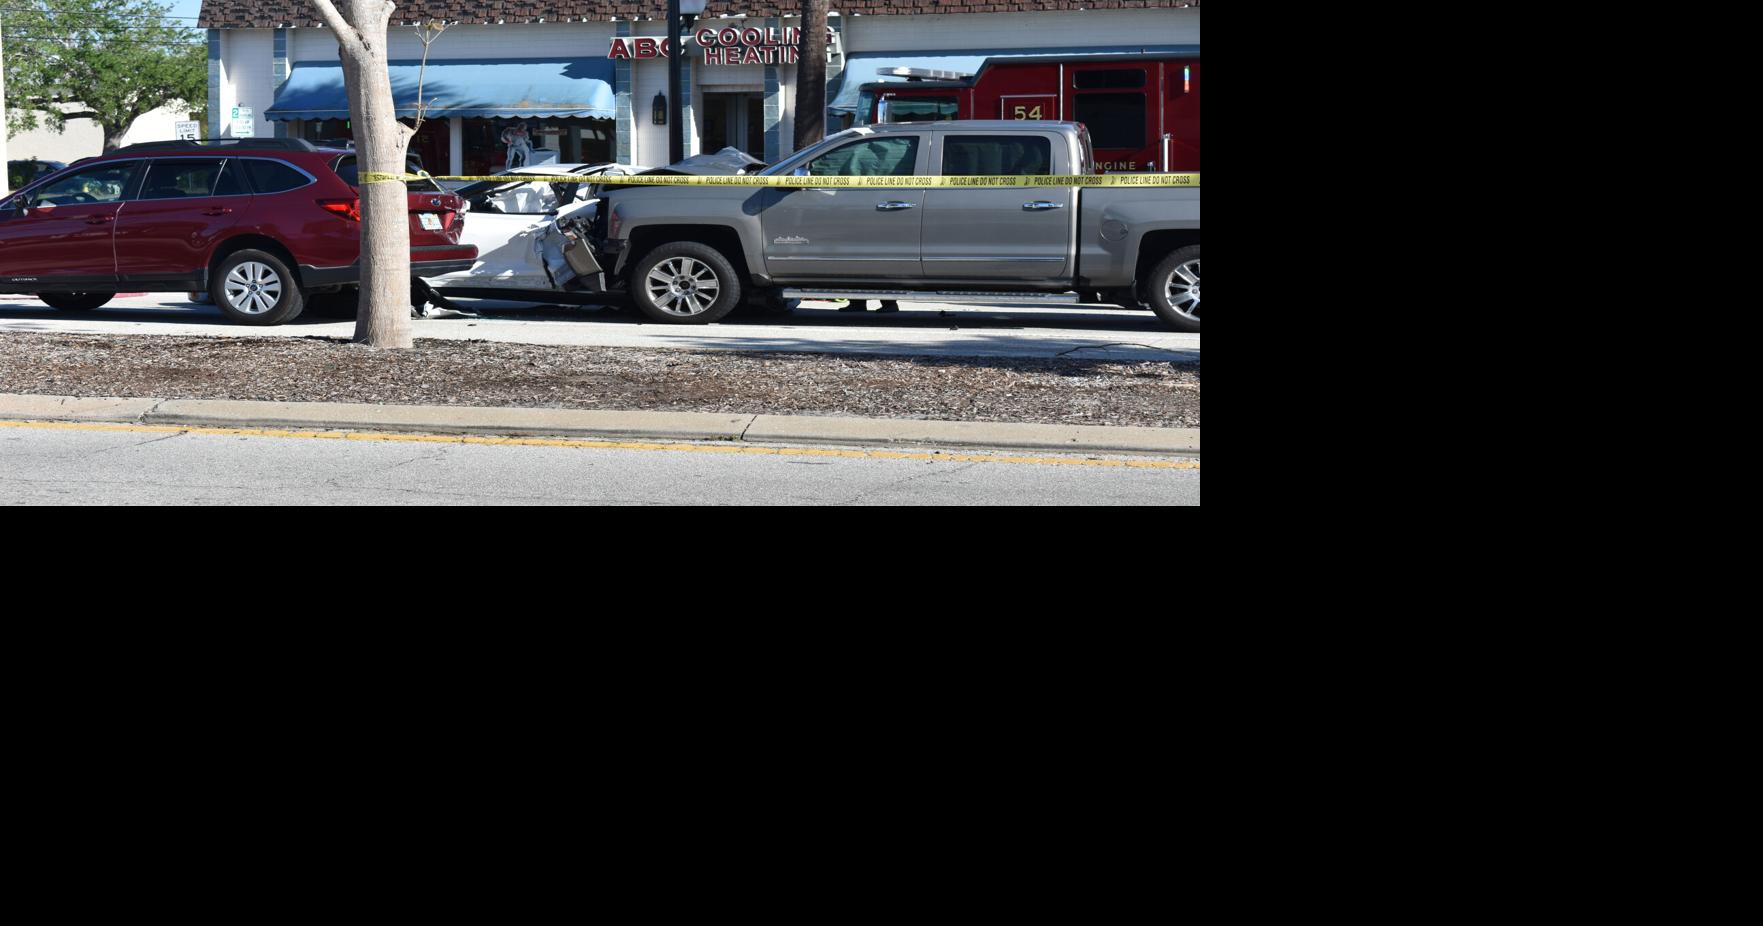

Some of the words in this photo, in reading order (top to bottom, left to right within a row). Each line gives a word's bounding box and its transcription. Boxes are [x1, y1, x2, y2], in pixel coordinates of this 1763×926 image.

[703, 46, 832, 65] HEATIN
[1014, 105, 1042, 120] 54
[1095, 162, 1137, 171] NGINE
[785, 177, 802, 185] POLICE
[804, 177, 814, 185] LINE
[815, 177, 822, 185] DO
[822, 177, 832, 185] NOT
[834, 177, 850, 186] CROSS
[866, 177, 884, 186] POLICE
[885, 177, 896, 186] LINE
[897, 177, 904, 186] DO
[904, 177, 914, 186] NOT
[916, 177, 932, 186] CROSS
[950, 177, 967, 186] POLICE
[968, 177, 980, 186] LINE
[980, 177, 987, 186] DO
[988, 177, 998, 186] NOT
[999, 177, 1016, 186] CROSS
[1034, 177, 1052, 186] POLICE
[1053, 177, 1064, 185] LINE
[1065, 177, 1072, 185] DO
[1074, 177, 1084, 185] NOT
[1085, 176, 1102, 184] CROSS
[1121, 176, 1138, 184] POLICE
[1140, 176, 1151, 184] LINE
[1152, 176, 1160, 184] DO
[1160, 176, 1171, 184] NOT
[1172, 176, 1190, 184] CROSS
